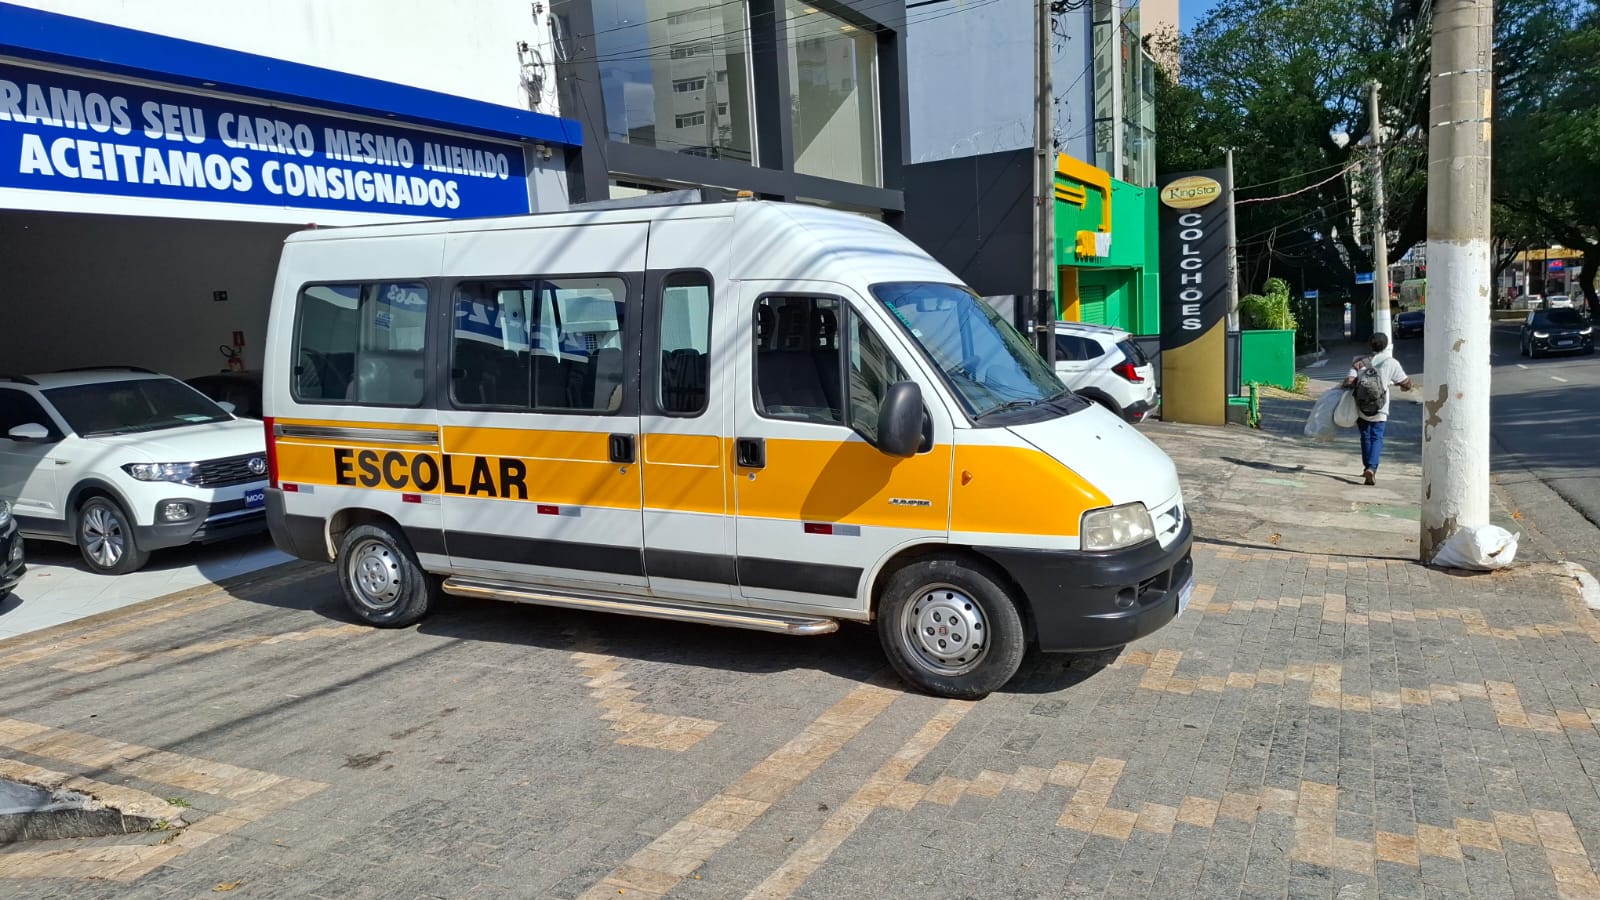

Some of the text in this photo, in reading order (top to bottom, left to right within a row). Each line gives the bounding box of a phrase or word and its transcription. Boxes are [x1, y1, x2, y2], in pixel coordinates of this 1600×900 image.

[0, 79, 509, 180] RAMOS SEU CARRO MESMO ALIENADO
[19, 133, 460, 209] ACEITAMOS CONSIGNADOS
[1169, 186, 1216, 200] King Star
[333, 447, 528, 500] ESCOLAR
